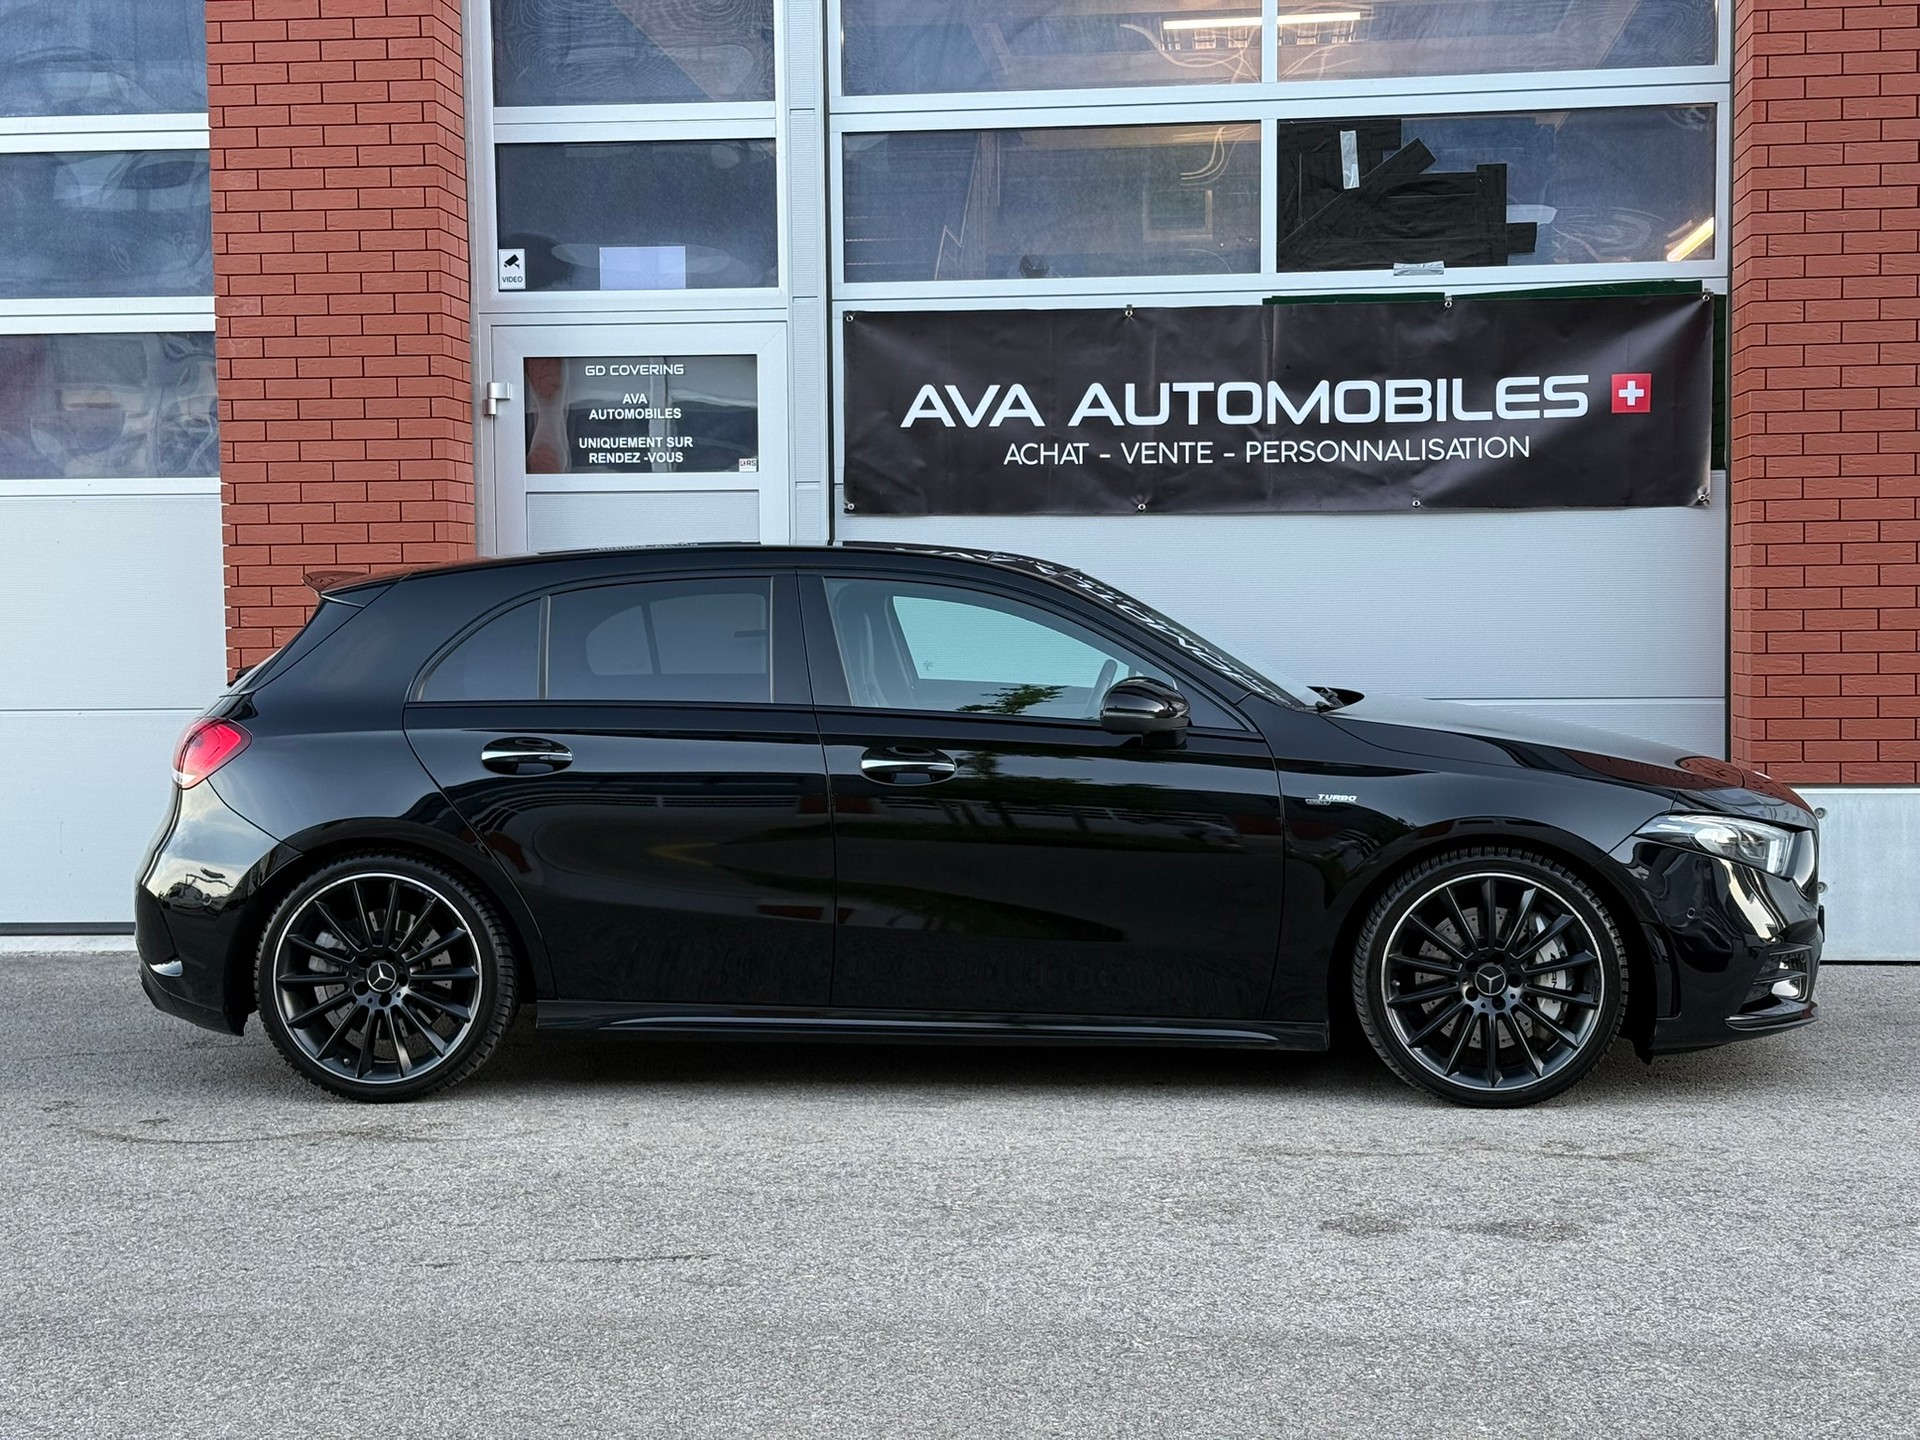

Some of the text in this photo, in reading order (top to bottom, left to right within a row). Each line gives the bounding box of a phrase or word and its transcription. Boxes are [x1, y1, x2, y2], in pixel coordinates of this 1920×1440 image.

[585, 364, 685, 376] GD COVERING
[622, 393, 648, 404] AVA
[900, 374, 1590, 428] AVA AUTOMOBILES
[589, 408, 682, 420] AUTOMOBILES
[579, 436, 694, 449] UNIQUEMENT SUR
[1003, 442, 1090, 466] ACHAT
[1121, 441, 1213, 464] VENTE
[1246, 435, 1531, 463] PERSONNALISATION
[1317, 793, 1358, 802] TURBO
